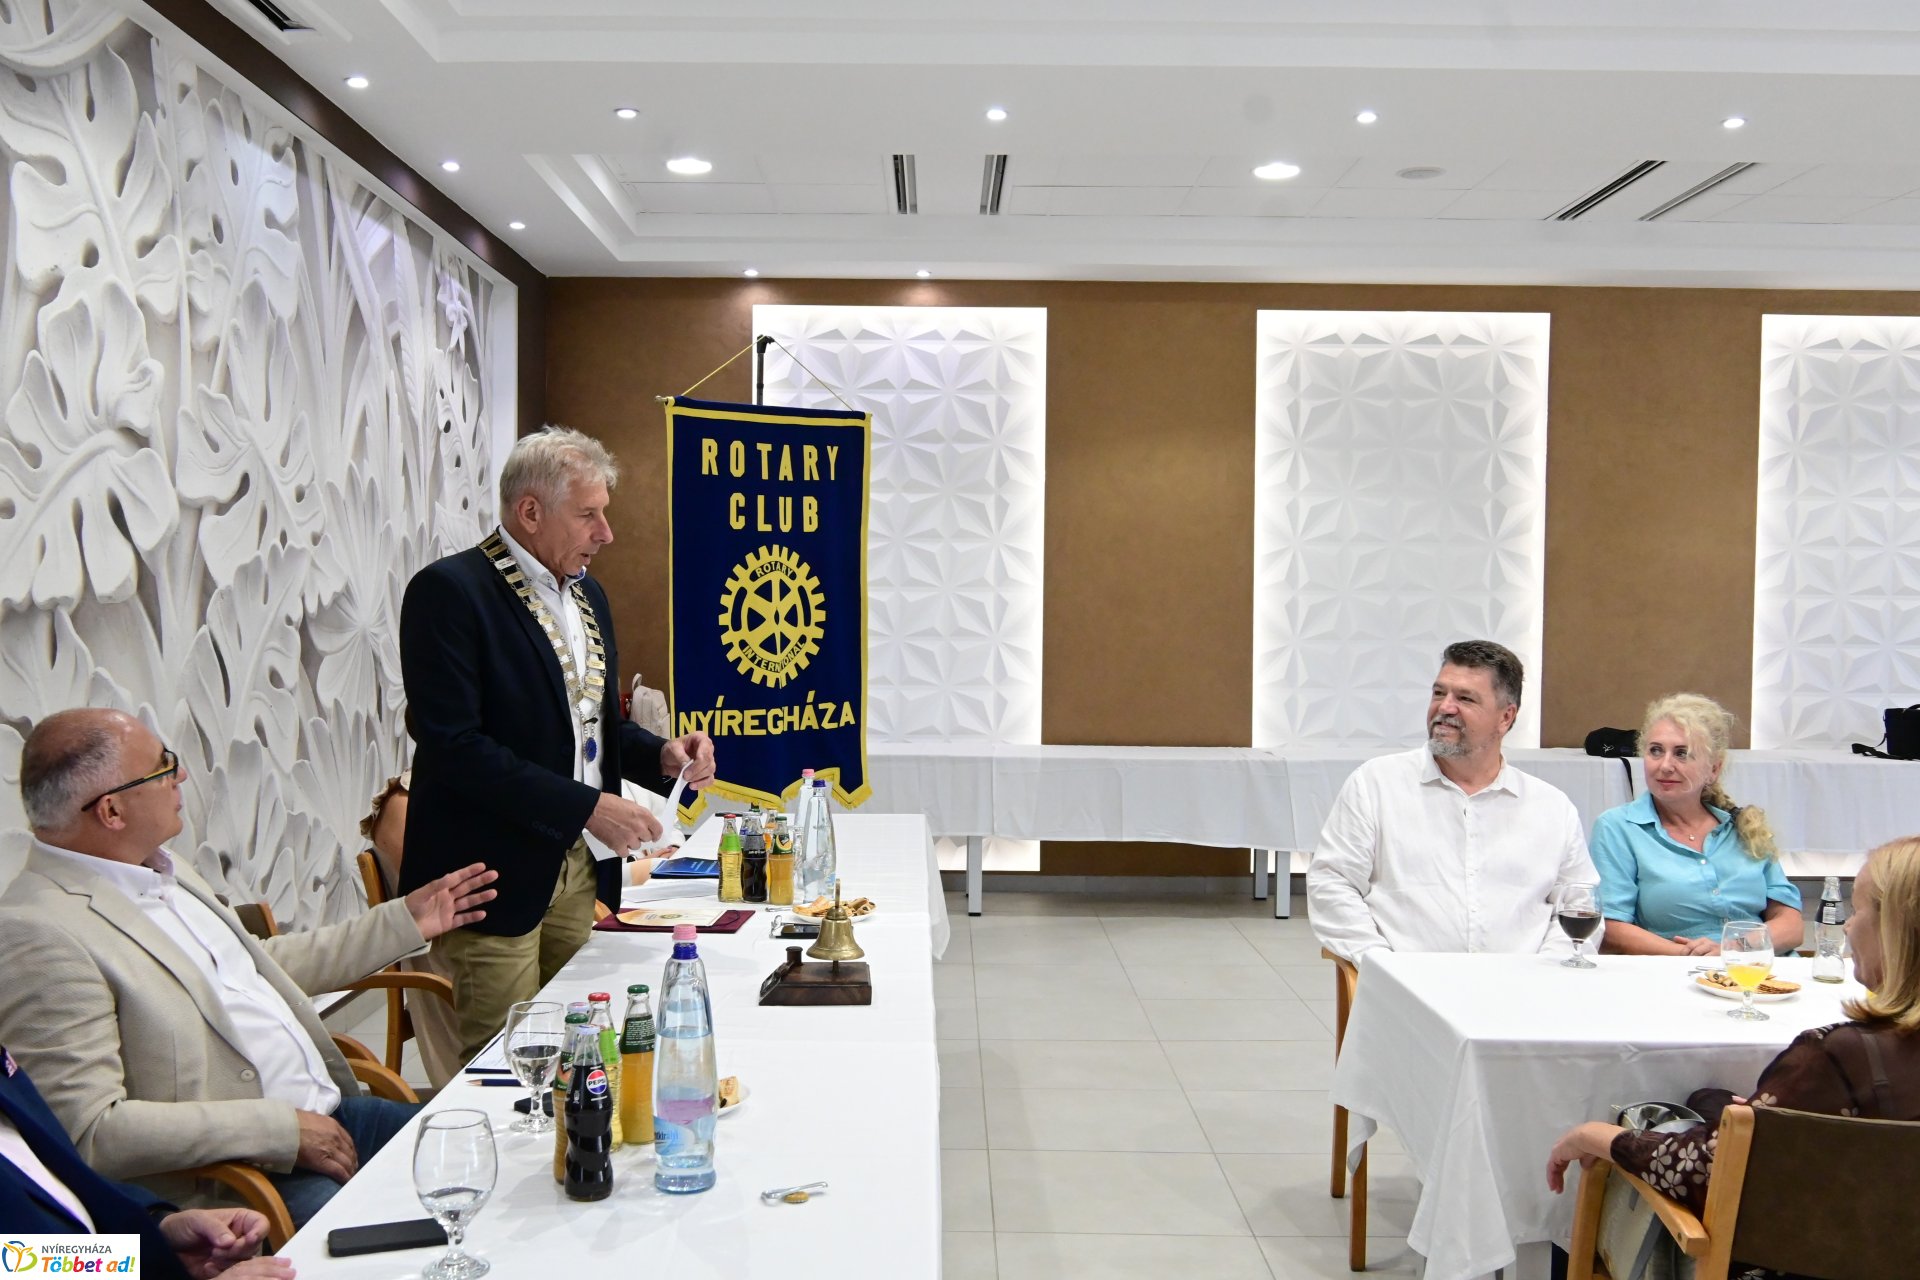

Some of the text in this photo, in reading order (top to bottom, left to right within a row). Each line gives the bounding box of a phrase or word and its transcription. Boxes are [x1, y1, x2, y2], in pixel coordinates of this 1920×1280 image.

[701, 438, 839, 481] ROTARY
[729, 492, 819, 533] CLUB
[755, 562, 794, 579] ROTARY
